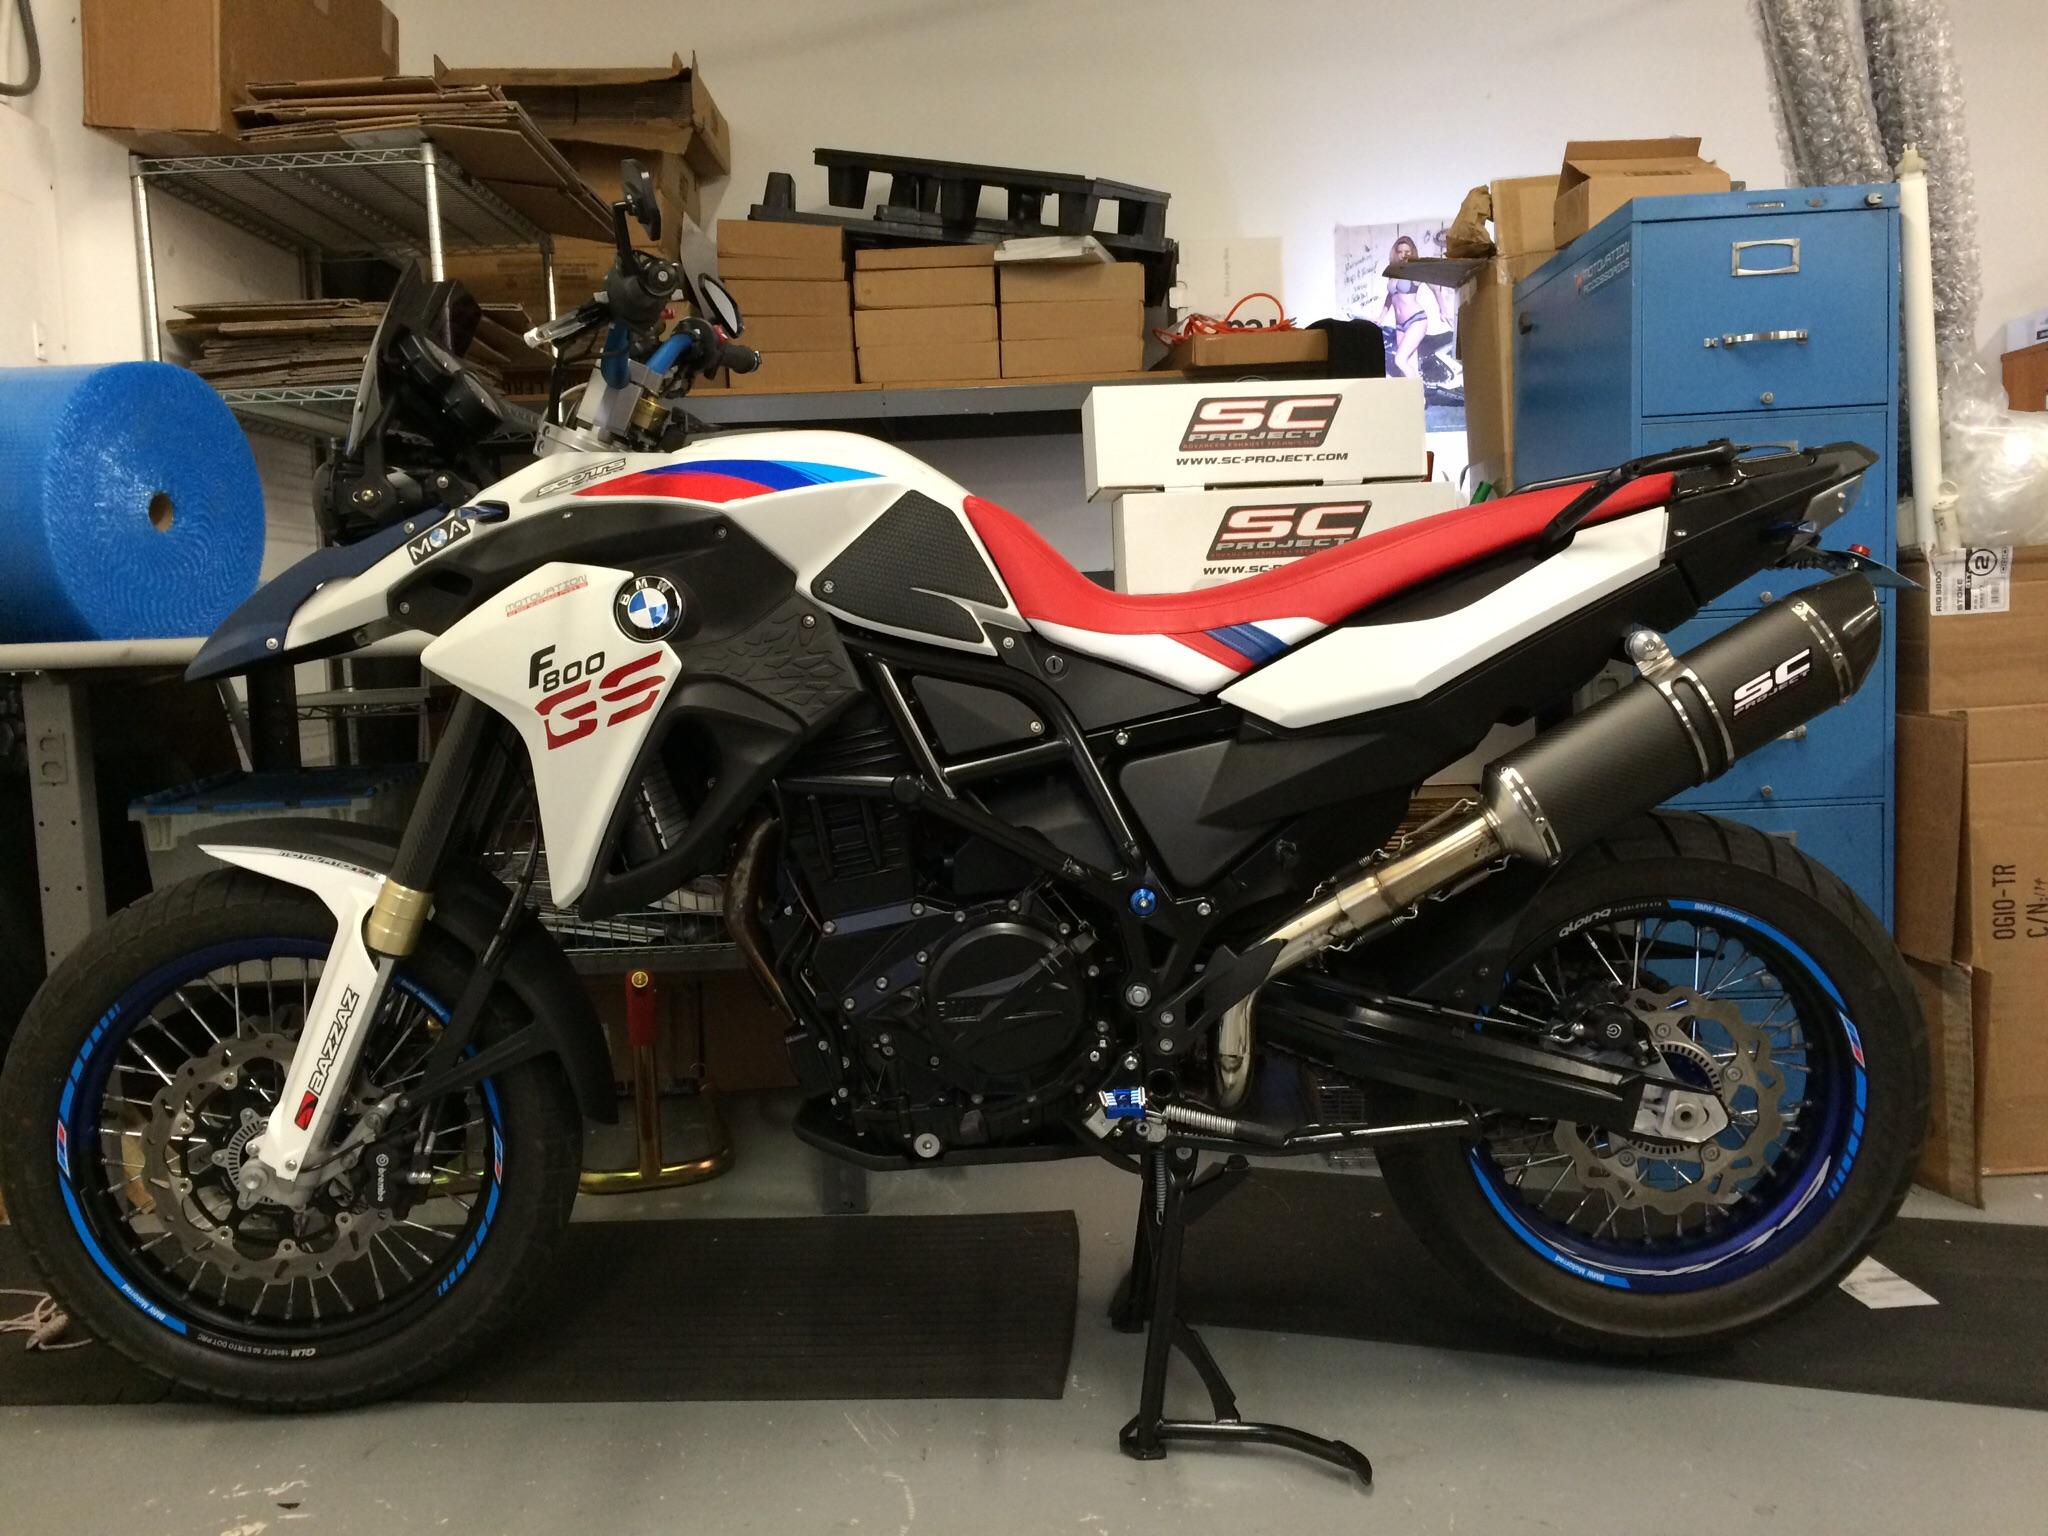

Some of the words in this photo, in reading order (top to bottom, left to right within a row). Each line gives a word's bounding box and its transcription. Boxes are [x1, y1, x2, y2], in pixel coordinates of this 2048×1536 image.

[1191, 397, 1338, 432] SC
[1188, 430, 1323, 442] PROJECT
[1176, 452, 1348, 466] WWW.SC-PROJECT.COM
[409, 519, 468, 561] MOA
[1219, 503, 1366, 541] SC
[1216, 537, 1350, 550] PROJECT
[1975, 555, 1990, 570] 2
[620, 578, 671, 607] BMW
[1733, 668, 1810, 717] PROJECT
[1734, 648, 1810, 710] SC
[534, 650, 666, 750] GS
[1992, 864, 2016, 940] OGIO-TR
[1559, 907, 1612, 938] alpina
[308, 984, 360, 1096] BAZZAZ
[376, 1167, 386, 1203] brembo
